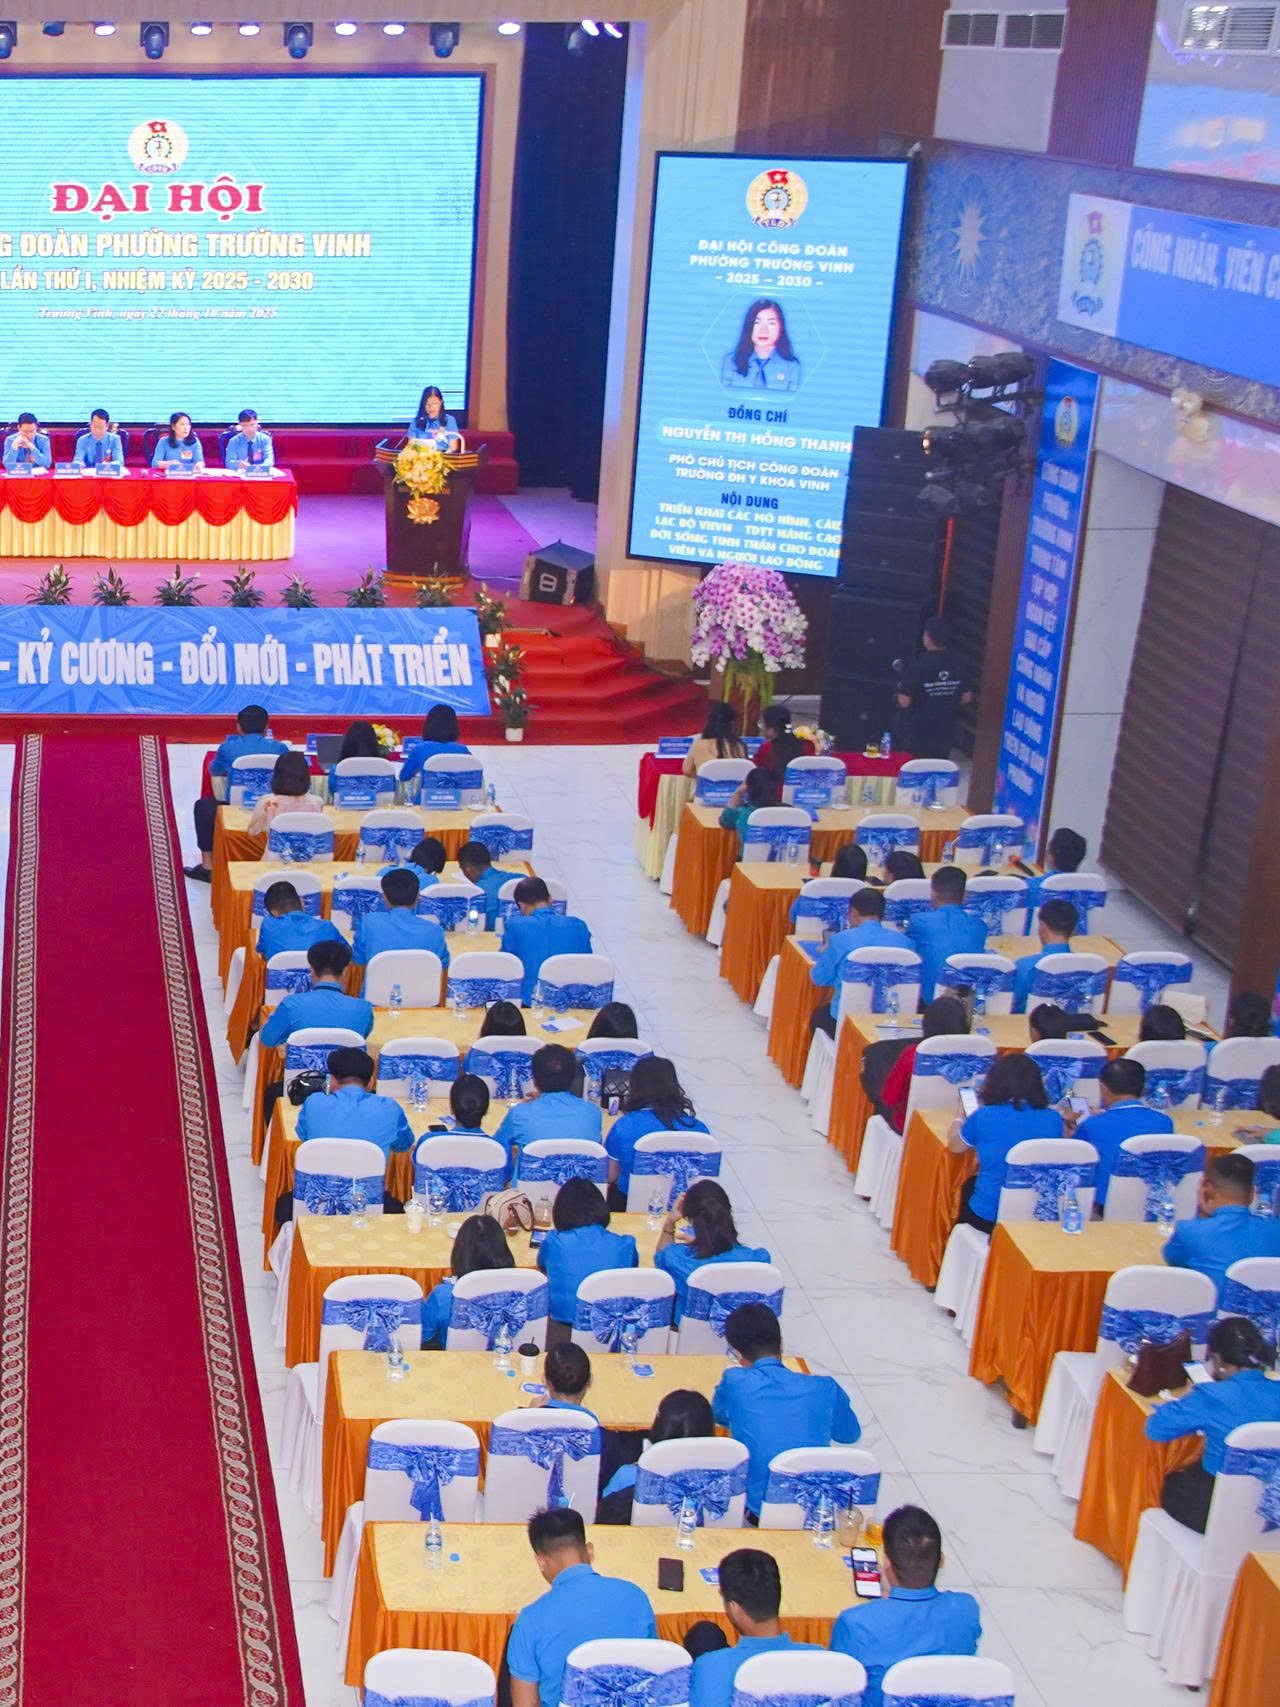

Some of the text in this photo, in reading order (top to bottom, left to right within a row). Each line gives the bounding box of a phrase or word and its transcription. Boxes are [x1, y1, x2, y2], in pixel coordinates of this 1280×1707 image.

[52, 176, 264, 221] ĐẠI HỘI
[19, 229, 89, 258] ĐOÀN
[96, 227, 198, 258] PHƯỜNG
[205, 227, 305, 258] TRƯỜNG
[312, 233, 371, 258] VINH
[698, 238, 848, 257] ĐẠI HỘI CÔNG ĐOÀN
[690, 255, 855, 274] PHƯỜNG TRƯỜNG VINH
[0, 266, 313, 294] LẦN THỨ I, NHIỆM KỲ 2025 2030
[726, 273, 812, 288] 2025 2030
[728, 405, 789, 423] ĐỒNG CHÍ
[662, 424, 852, 453] NGUYỄN THỊ HỒNG THANH
[669, 453, 839, 479] PHÓ CHỦ TỊCH CÔNG ĐOÀN
[675, 467, 830, 492] TRƯỜNG ĐH Y KHOA VINH
[721, 491, 779, 510] NỘI DUNG
[18, 627, 53, 684] KỶ
[61, 637, 153, 686] CƯƠNG
[180, 625, 227, 686] ĐỔI
[233, 634, 288, 686] MỚI
[313, 635, 383, 686] PHÁT
[389, 627, 473, 687] TRIỂN
